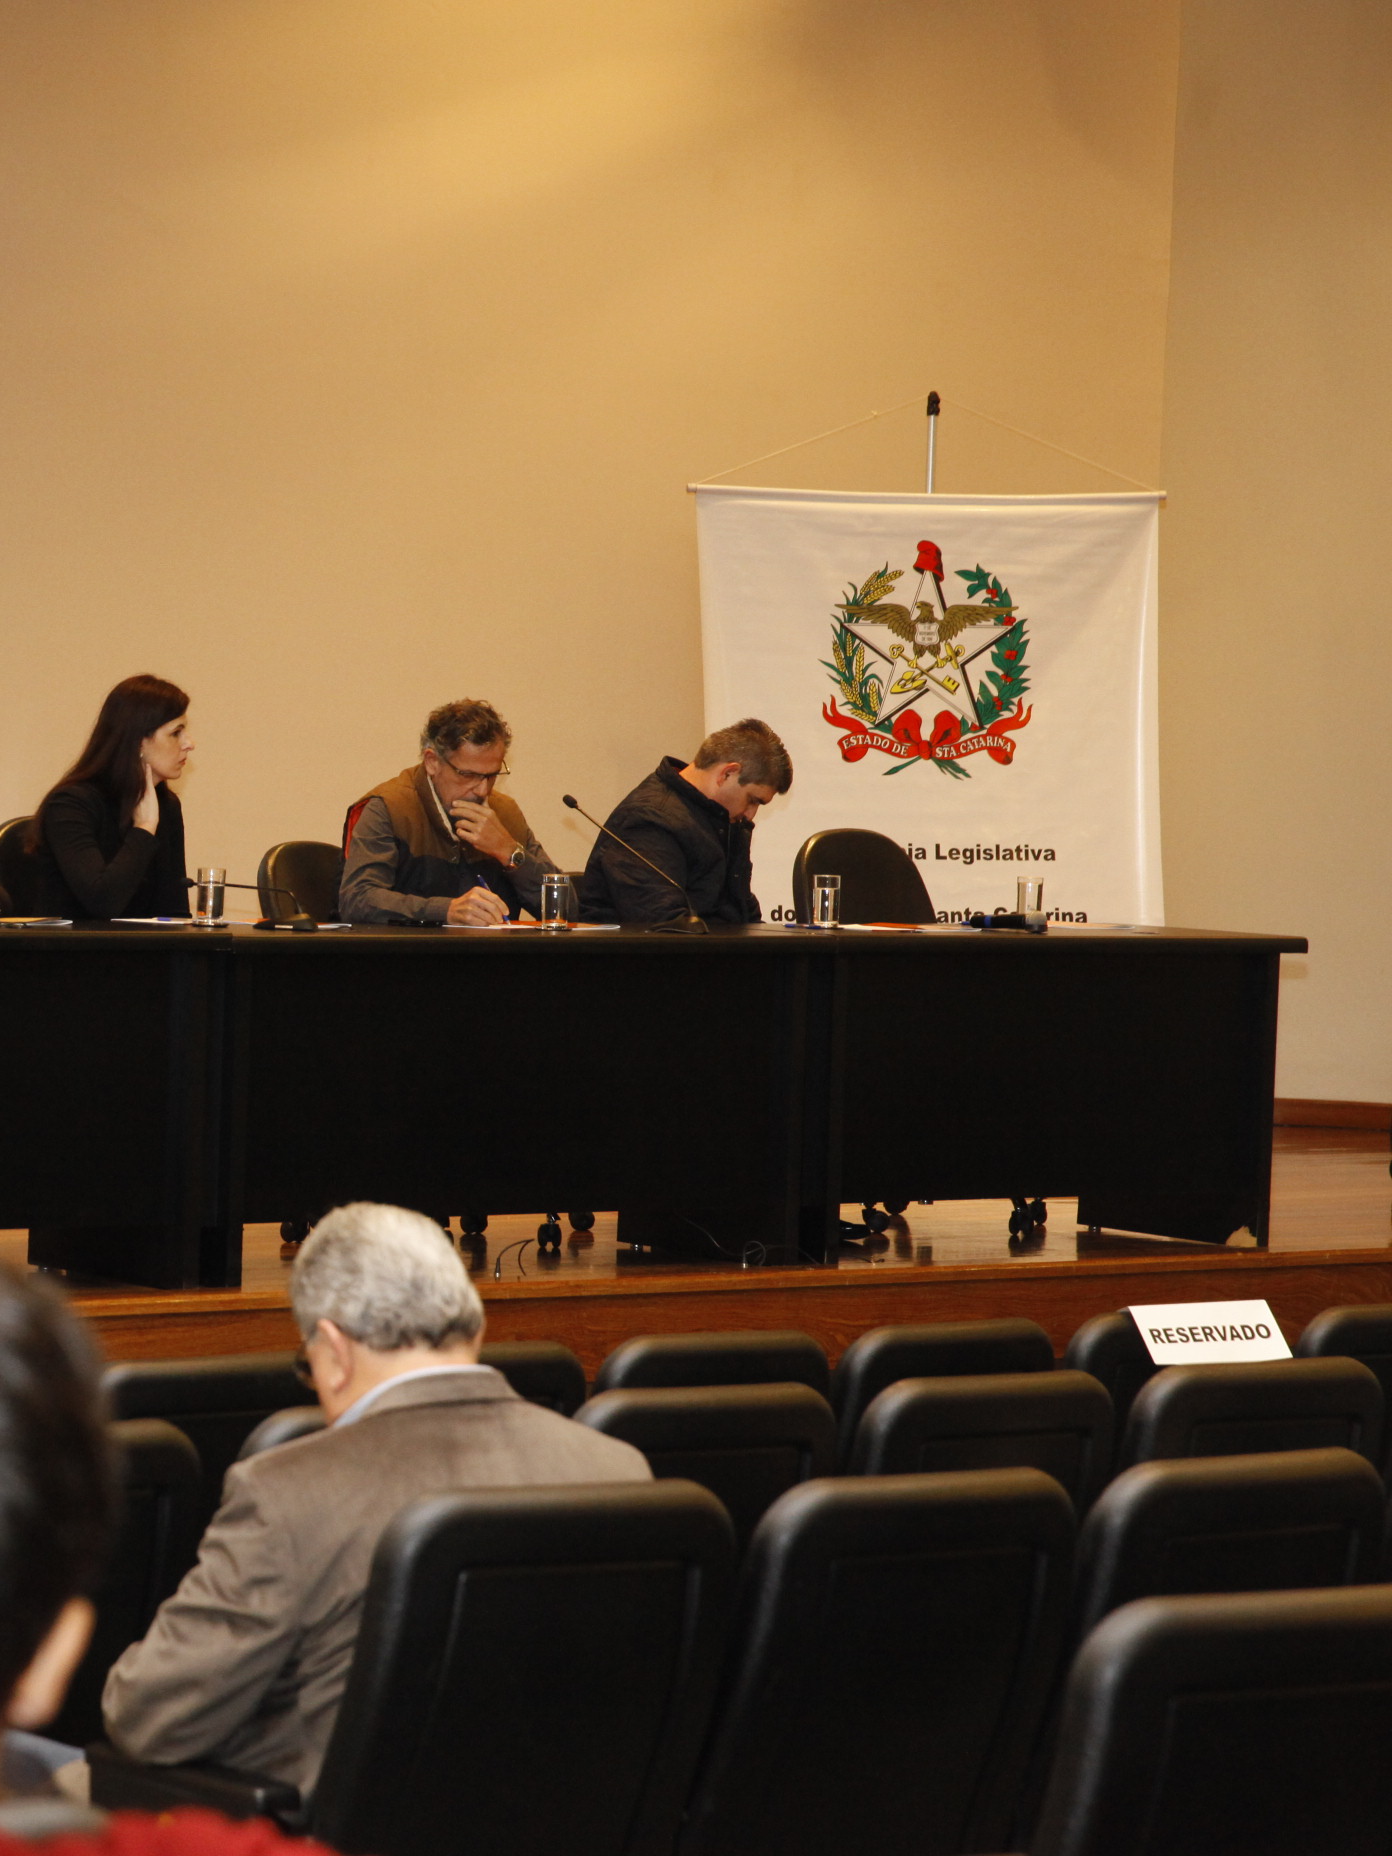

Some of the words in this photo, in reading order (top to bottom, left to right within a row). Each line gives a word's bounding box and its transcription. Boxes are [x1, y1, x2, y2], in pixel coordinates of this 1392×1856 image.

[842, 734, 890, 750] ESTADO
[892, 744, 909, 757] DE
[960, 737, 1012, 754] CATARINA
[935, 843, 1057, 865] Legislativa
[770, 905, 797, 922] do
[1148, 1323, 1272, 1345] RESERVADO
